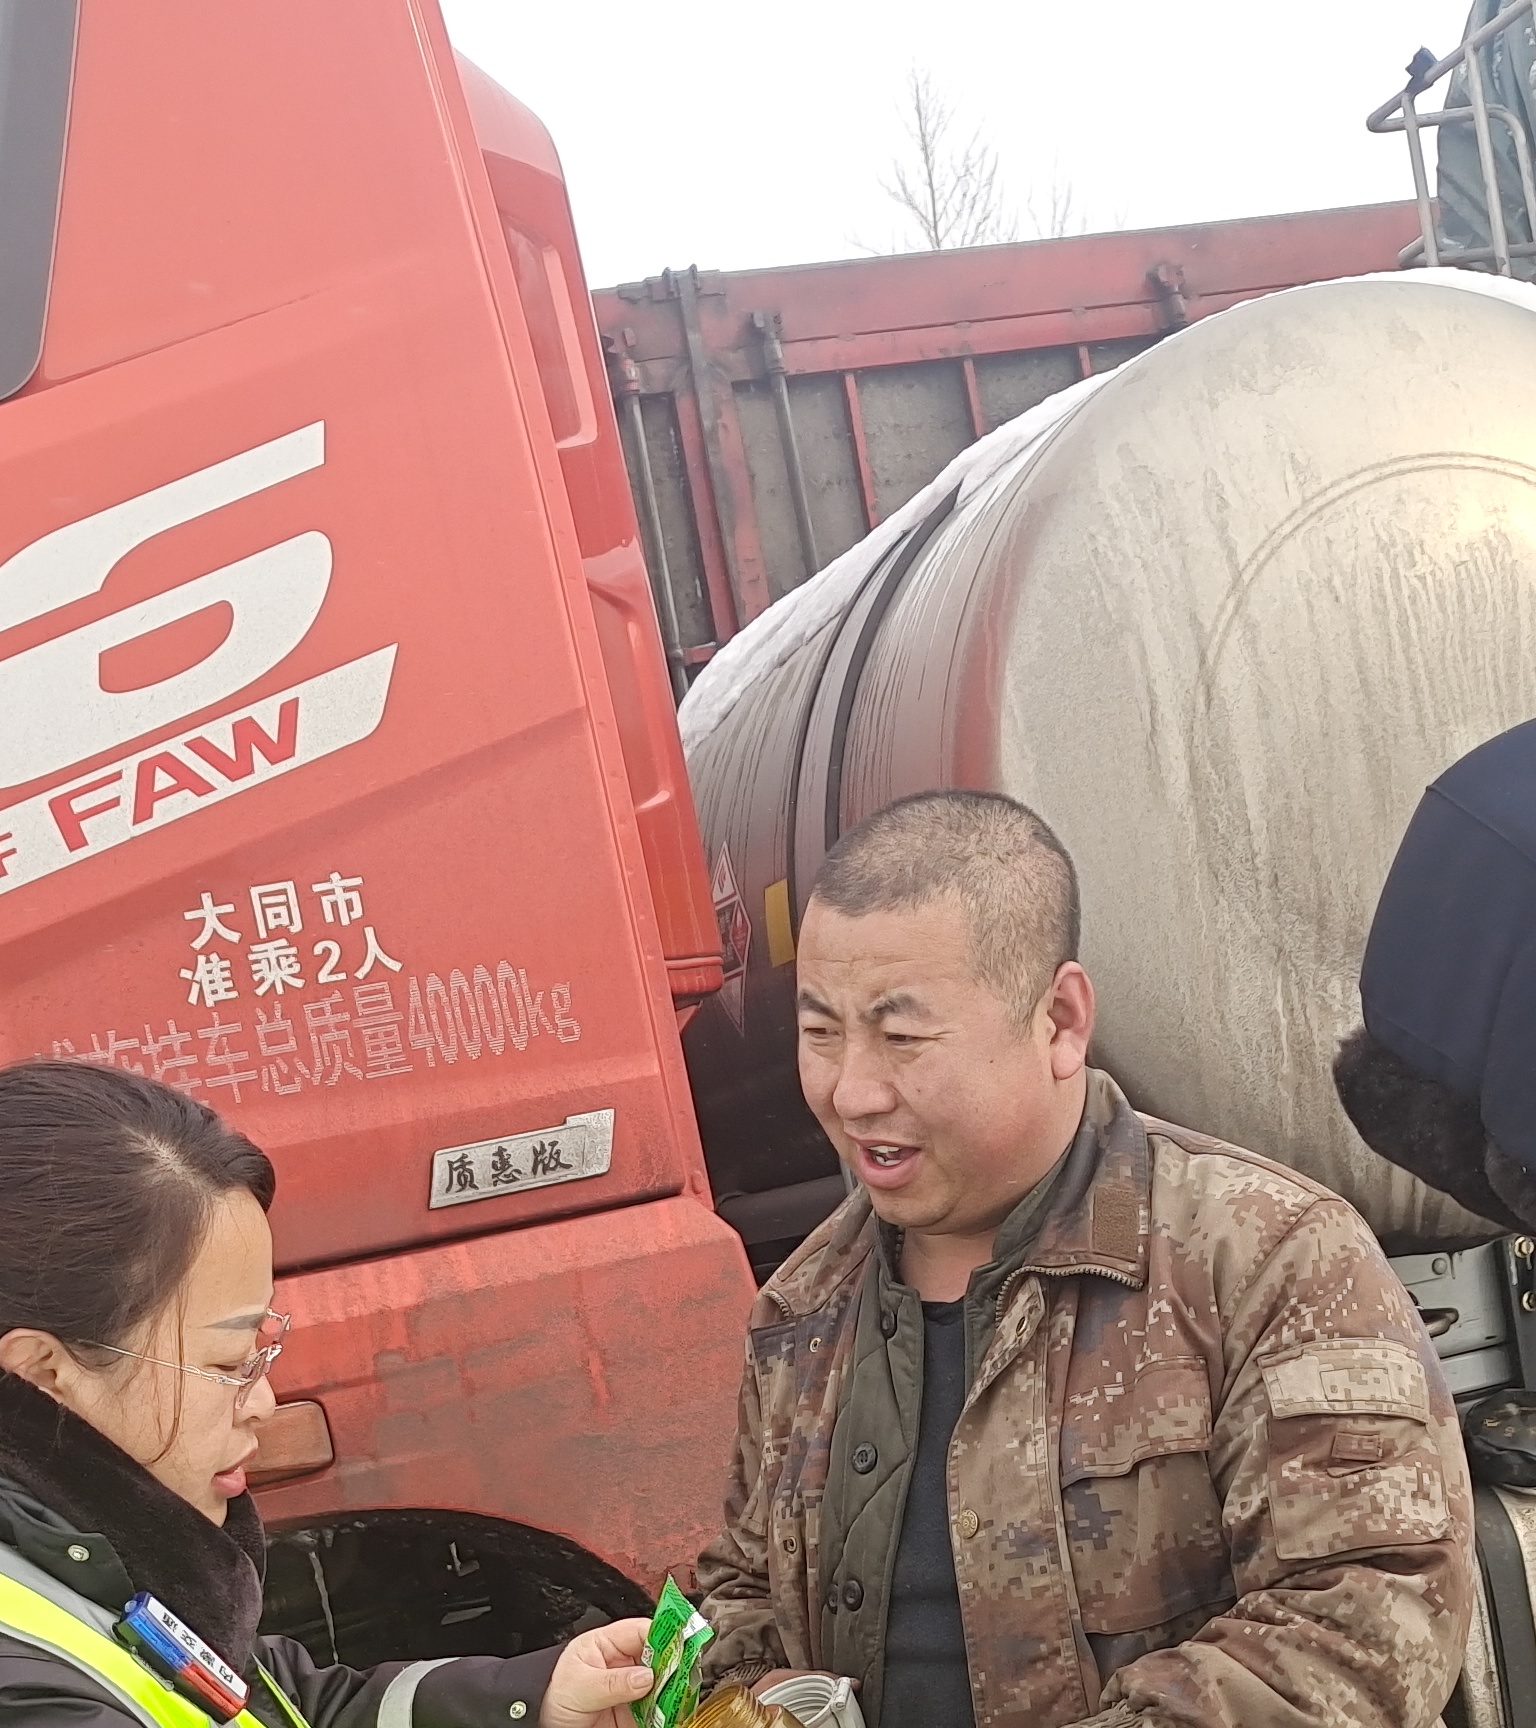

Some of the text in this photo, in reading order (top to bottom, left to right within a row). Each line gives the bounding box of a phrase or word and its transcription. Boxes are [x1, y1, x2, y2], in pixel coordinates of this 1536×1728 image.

[48, 697, 300, 853] FAW
[183, 871, 364, 950] 大同市
[178, 925, 403, 1007] 准乘2人
[445, 1140, 573, 1194] 质惠版
